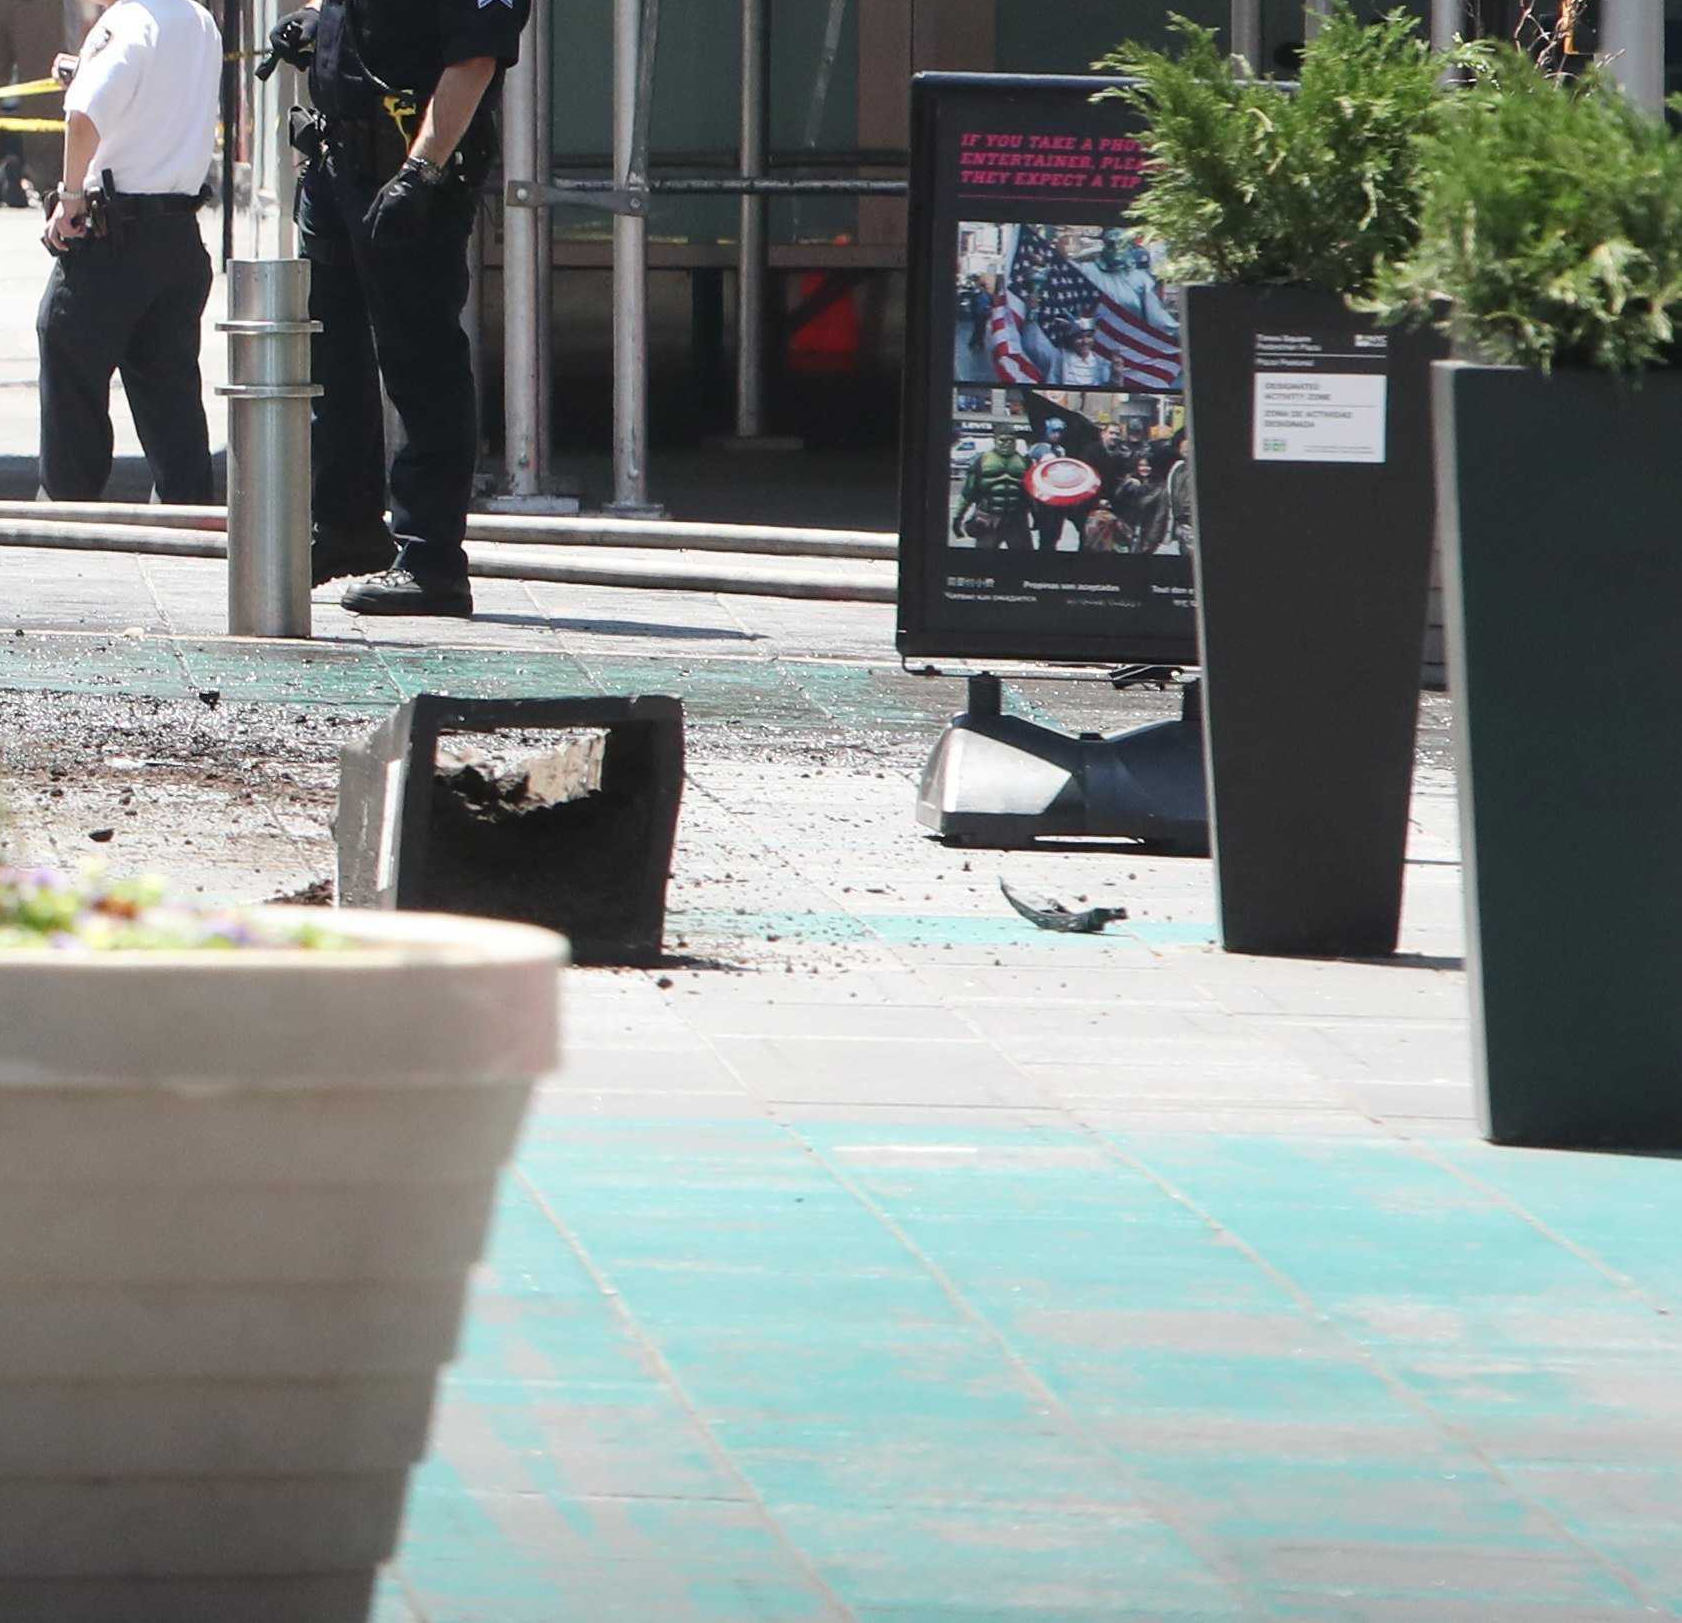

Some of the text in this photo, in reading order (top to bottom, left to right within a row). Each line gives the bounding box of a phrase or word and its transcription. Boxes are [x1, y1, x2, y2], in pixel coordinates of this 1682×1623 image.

[960, 133, 981, 147] IF
[986, 134, 1024, 149] YOU
[1028, 135, 1077, 150] TAKE
[1080, 138, 1094, 151] A
[959, 170, 1012, 186] THEY
[1014, 171, 1089, 187] EXPECT
[1091, 174, 1105, 188] A
